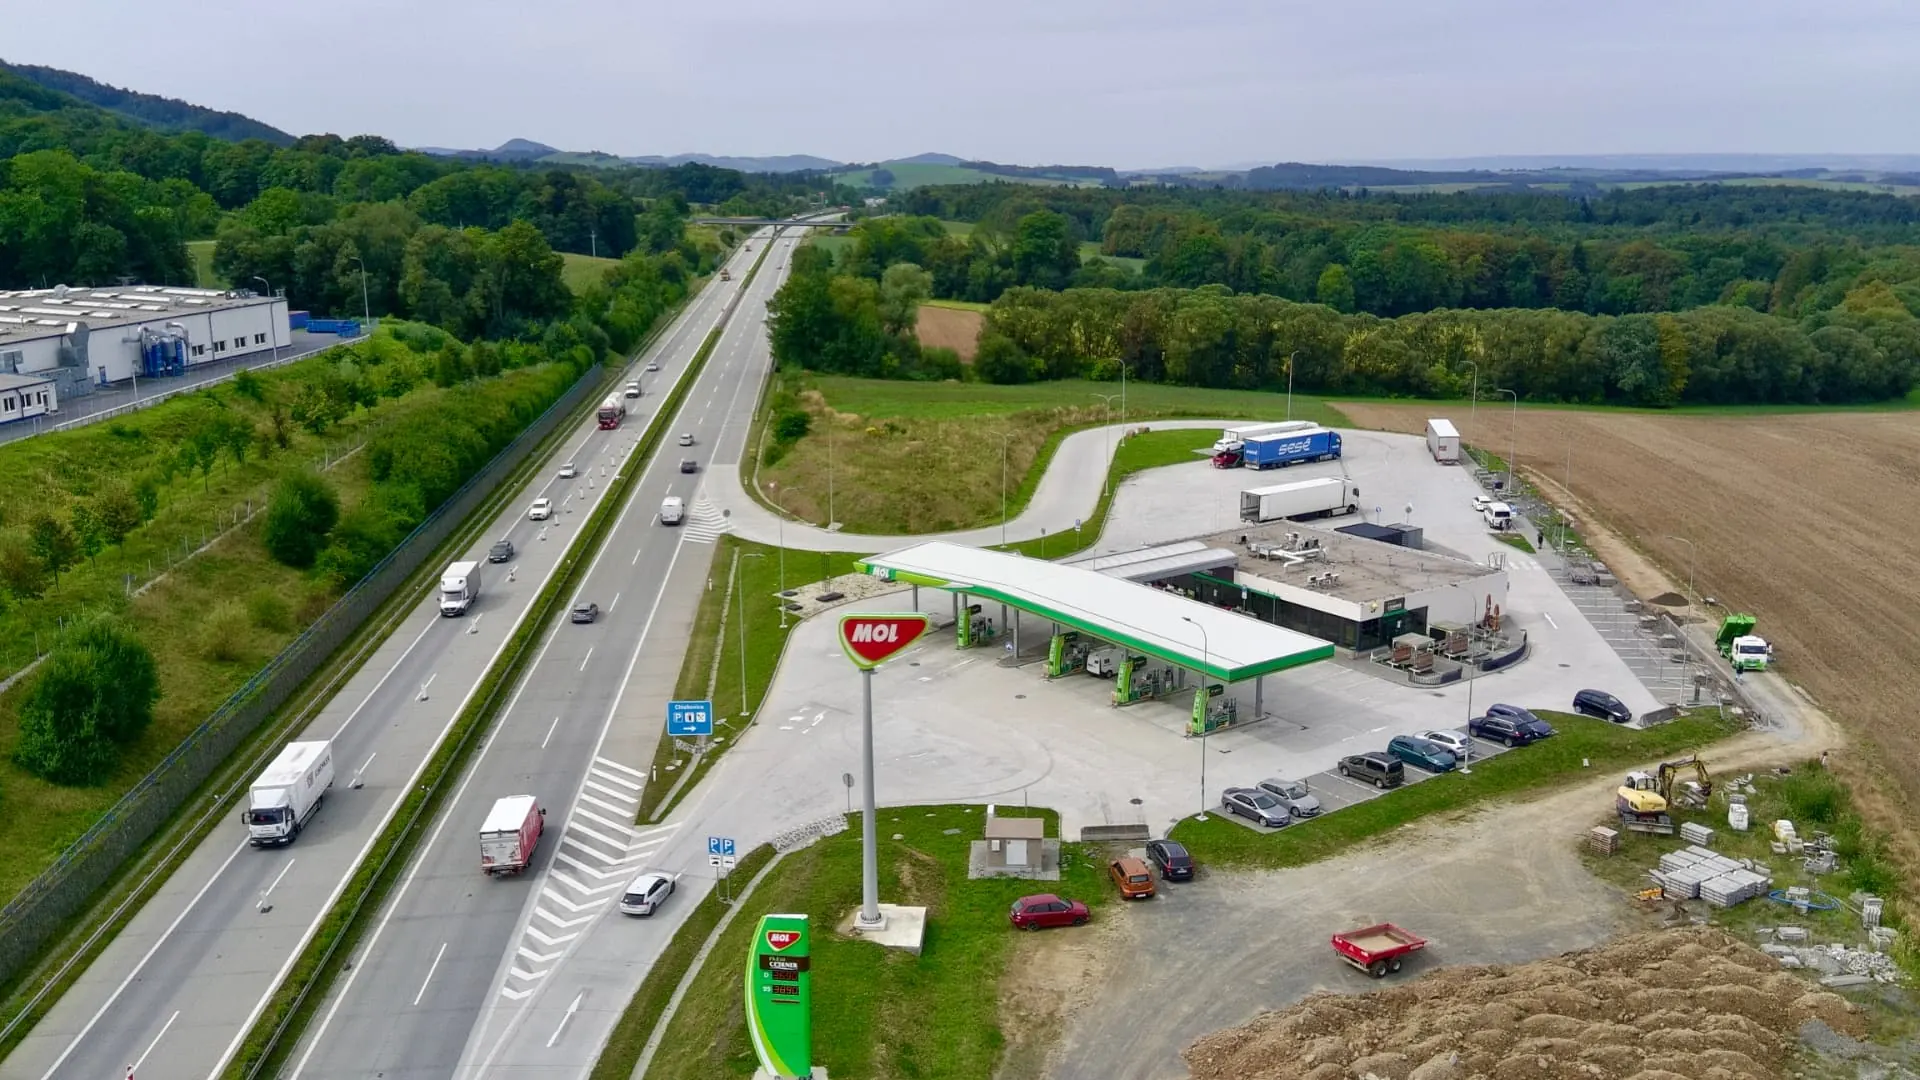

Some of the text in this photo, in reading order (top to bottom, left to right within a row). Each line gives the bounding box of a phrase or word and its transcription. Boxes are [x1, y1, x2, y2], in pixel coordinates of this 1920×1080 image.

[872, 566, 889, 578] MOL
[851, 623, 899, 643] MOL
[711, 838, 718, 848] P
[724, 839, 732, 850] P
[771, 934, 790, 942] MOL
